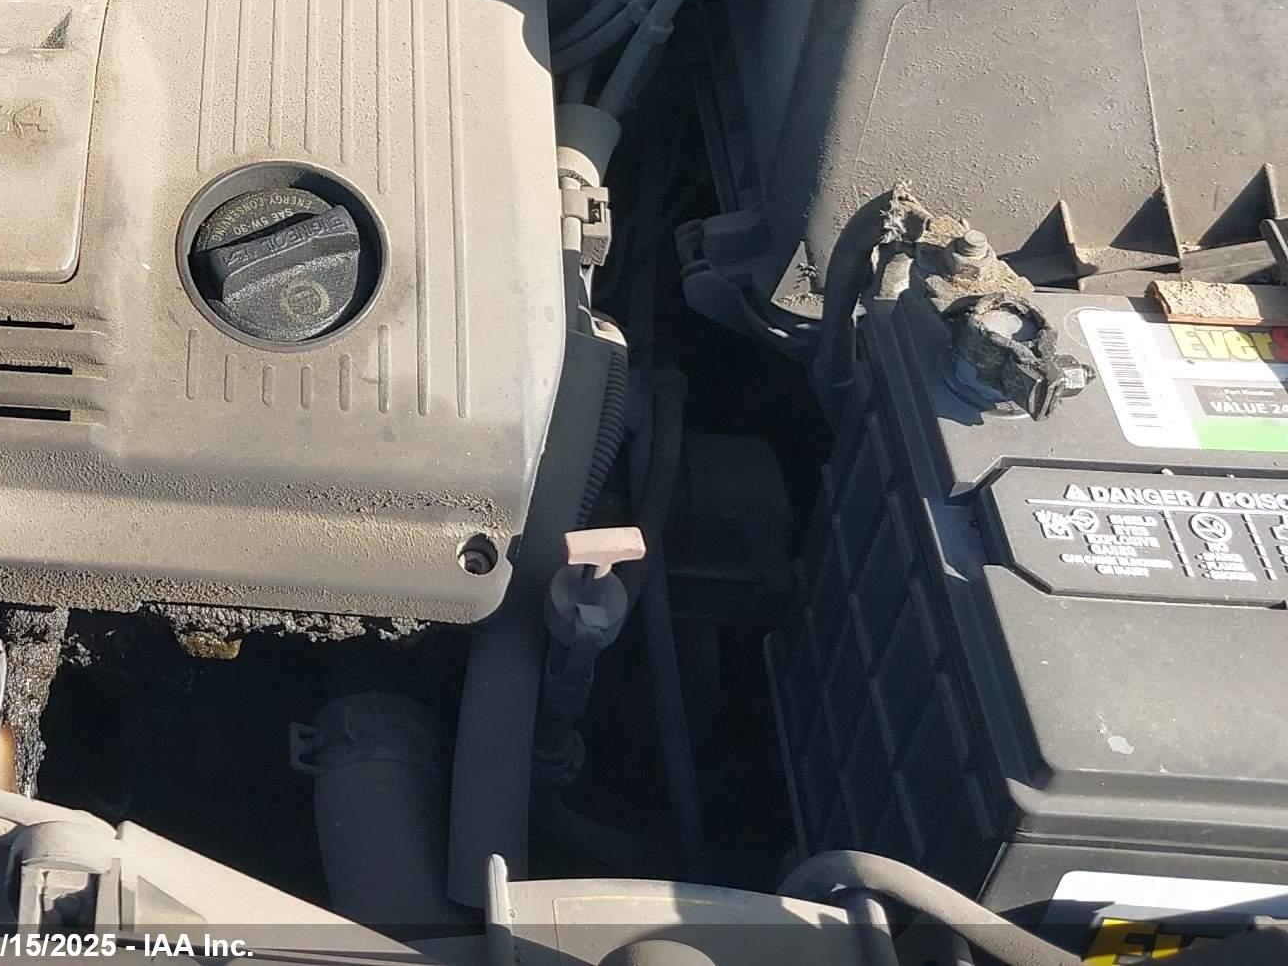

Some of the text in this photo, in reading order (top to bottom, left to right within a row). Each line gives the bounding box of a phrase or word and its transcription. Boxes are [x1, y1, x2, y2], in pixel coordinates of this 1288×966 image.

[210, 194, 313, 242] ENERGY CONSERVING
[232, 207, 295, 237] SAE 5W-30
[1209, 401, 1268, 414] VALUE
[1089, 487, 1196, 506] DANGER
